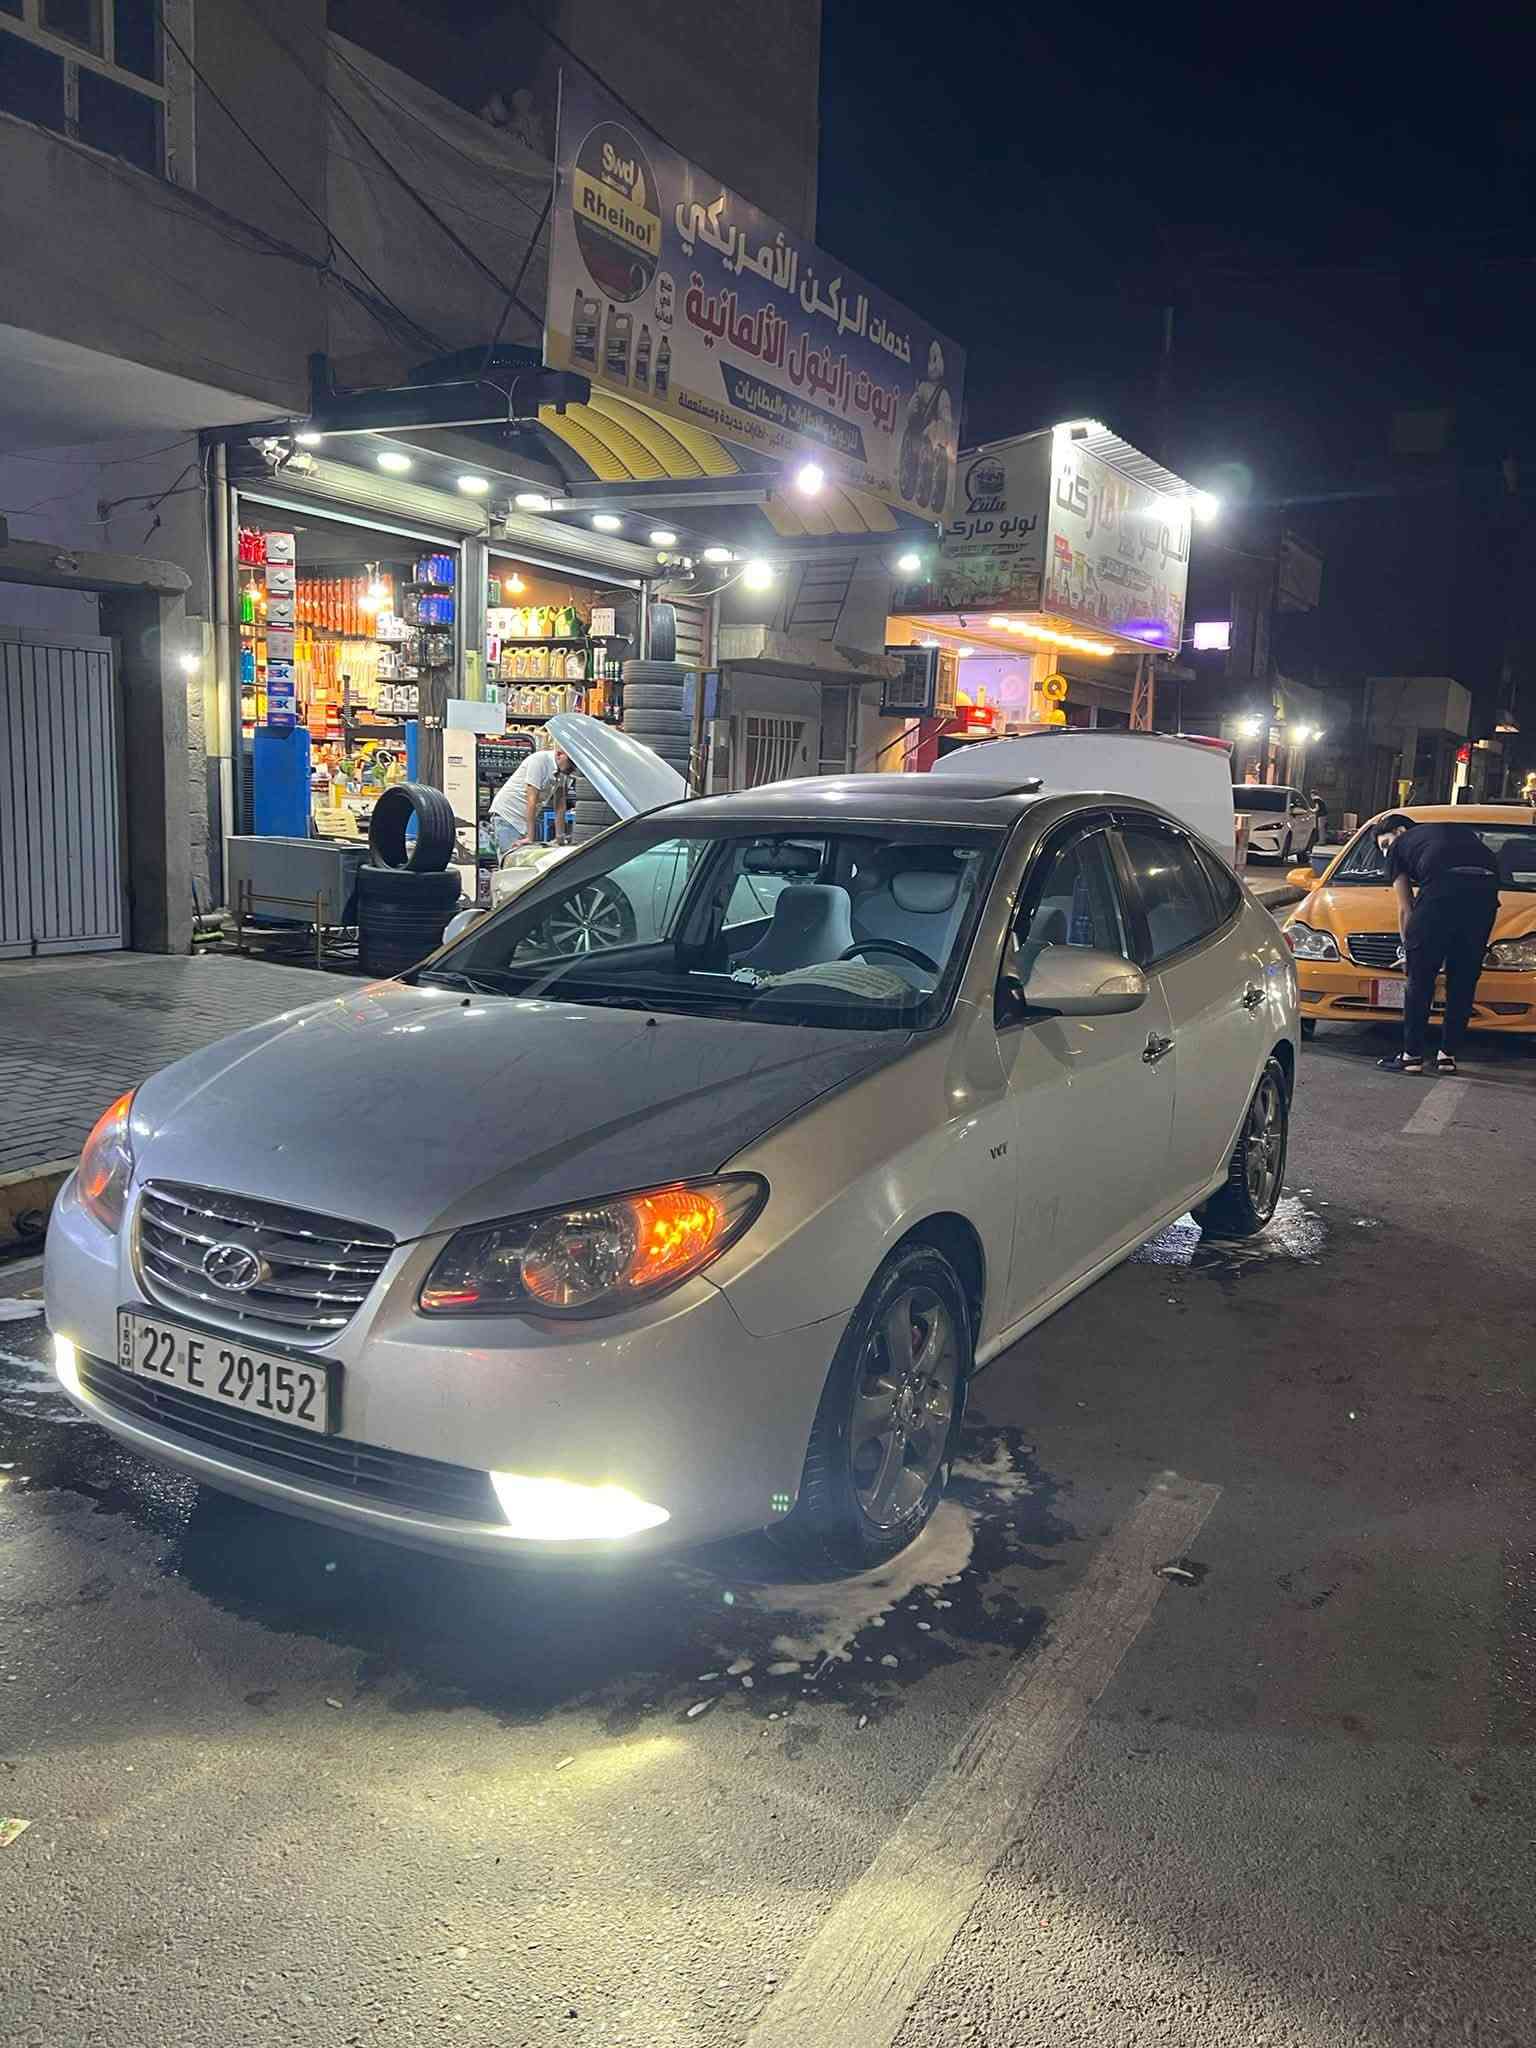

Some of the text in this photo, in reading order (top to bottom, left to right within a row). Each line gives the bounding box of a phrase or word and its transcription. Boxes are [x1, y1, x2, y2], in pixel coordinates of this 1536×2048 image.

[583, 186, 651, 245] Rheinol
[675, 191, 912, 364] خدمات الركن الأمريكي
[686, 271, 788, 369] الألمانية
[677, 391, 720, 423] ومستعملة
[788, 332, 851, 414] راينول
[854, 370, 899, 435] زيوت
[946, 515, 1038, 541] لولو مارك
[142, 1327, 317, 1423] 22 E 29152
